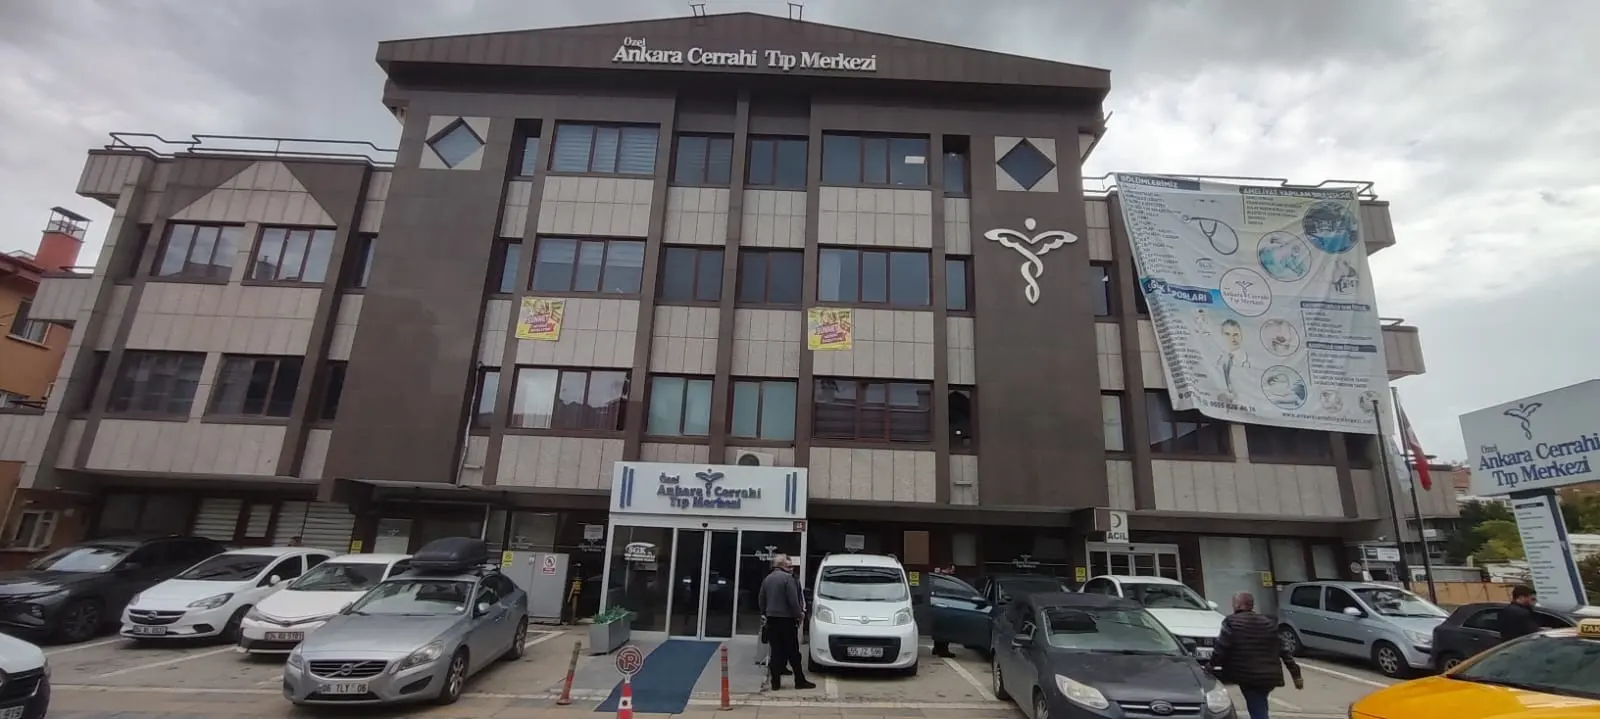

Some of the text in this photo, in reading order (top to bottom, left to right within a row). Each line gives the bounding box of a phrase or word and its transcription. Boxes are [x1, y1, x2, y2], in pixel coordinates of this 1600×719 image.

[624, 36, 645, 47] Özel
[612, 46, 877, 71] Ankara Cerrahi Tıp Merkezi
[1479, 432, 1600, 471] Ankara Cerrahi
[1492, 455, 1591, 488] Tıp Merkezi
[657, 484, 761, 500] Ankara Cerrahi
[669, 496, 742, 510] Tıp Merkezi
